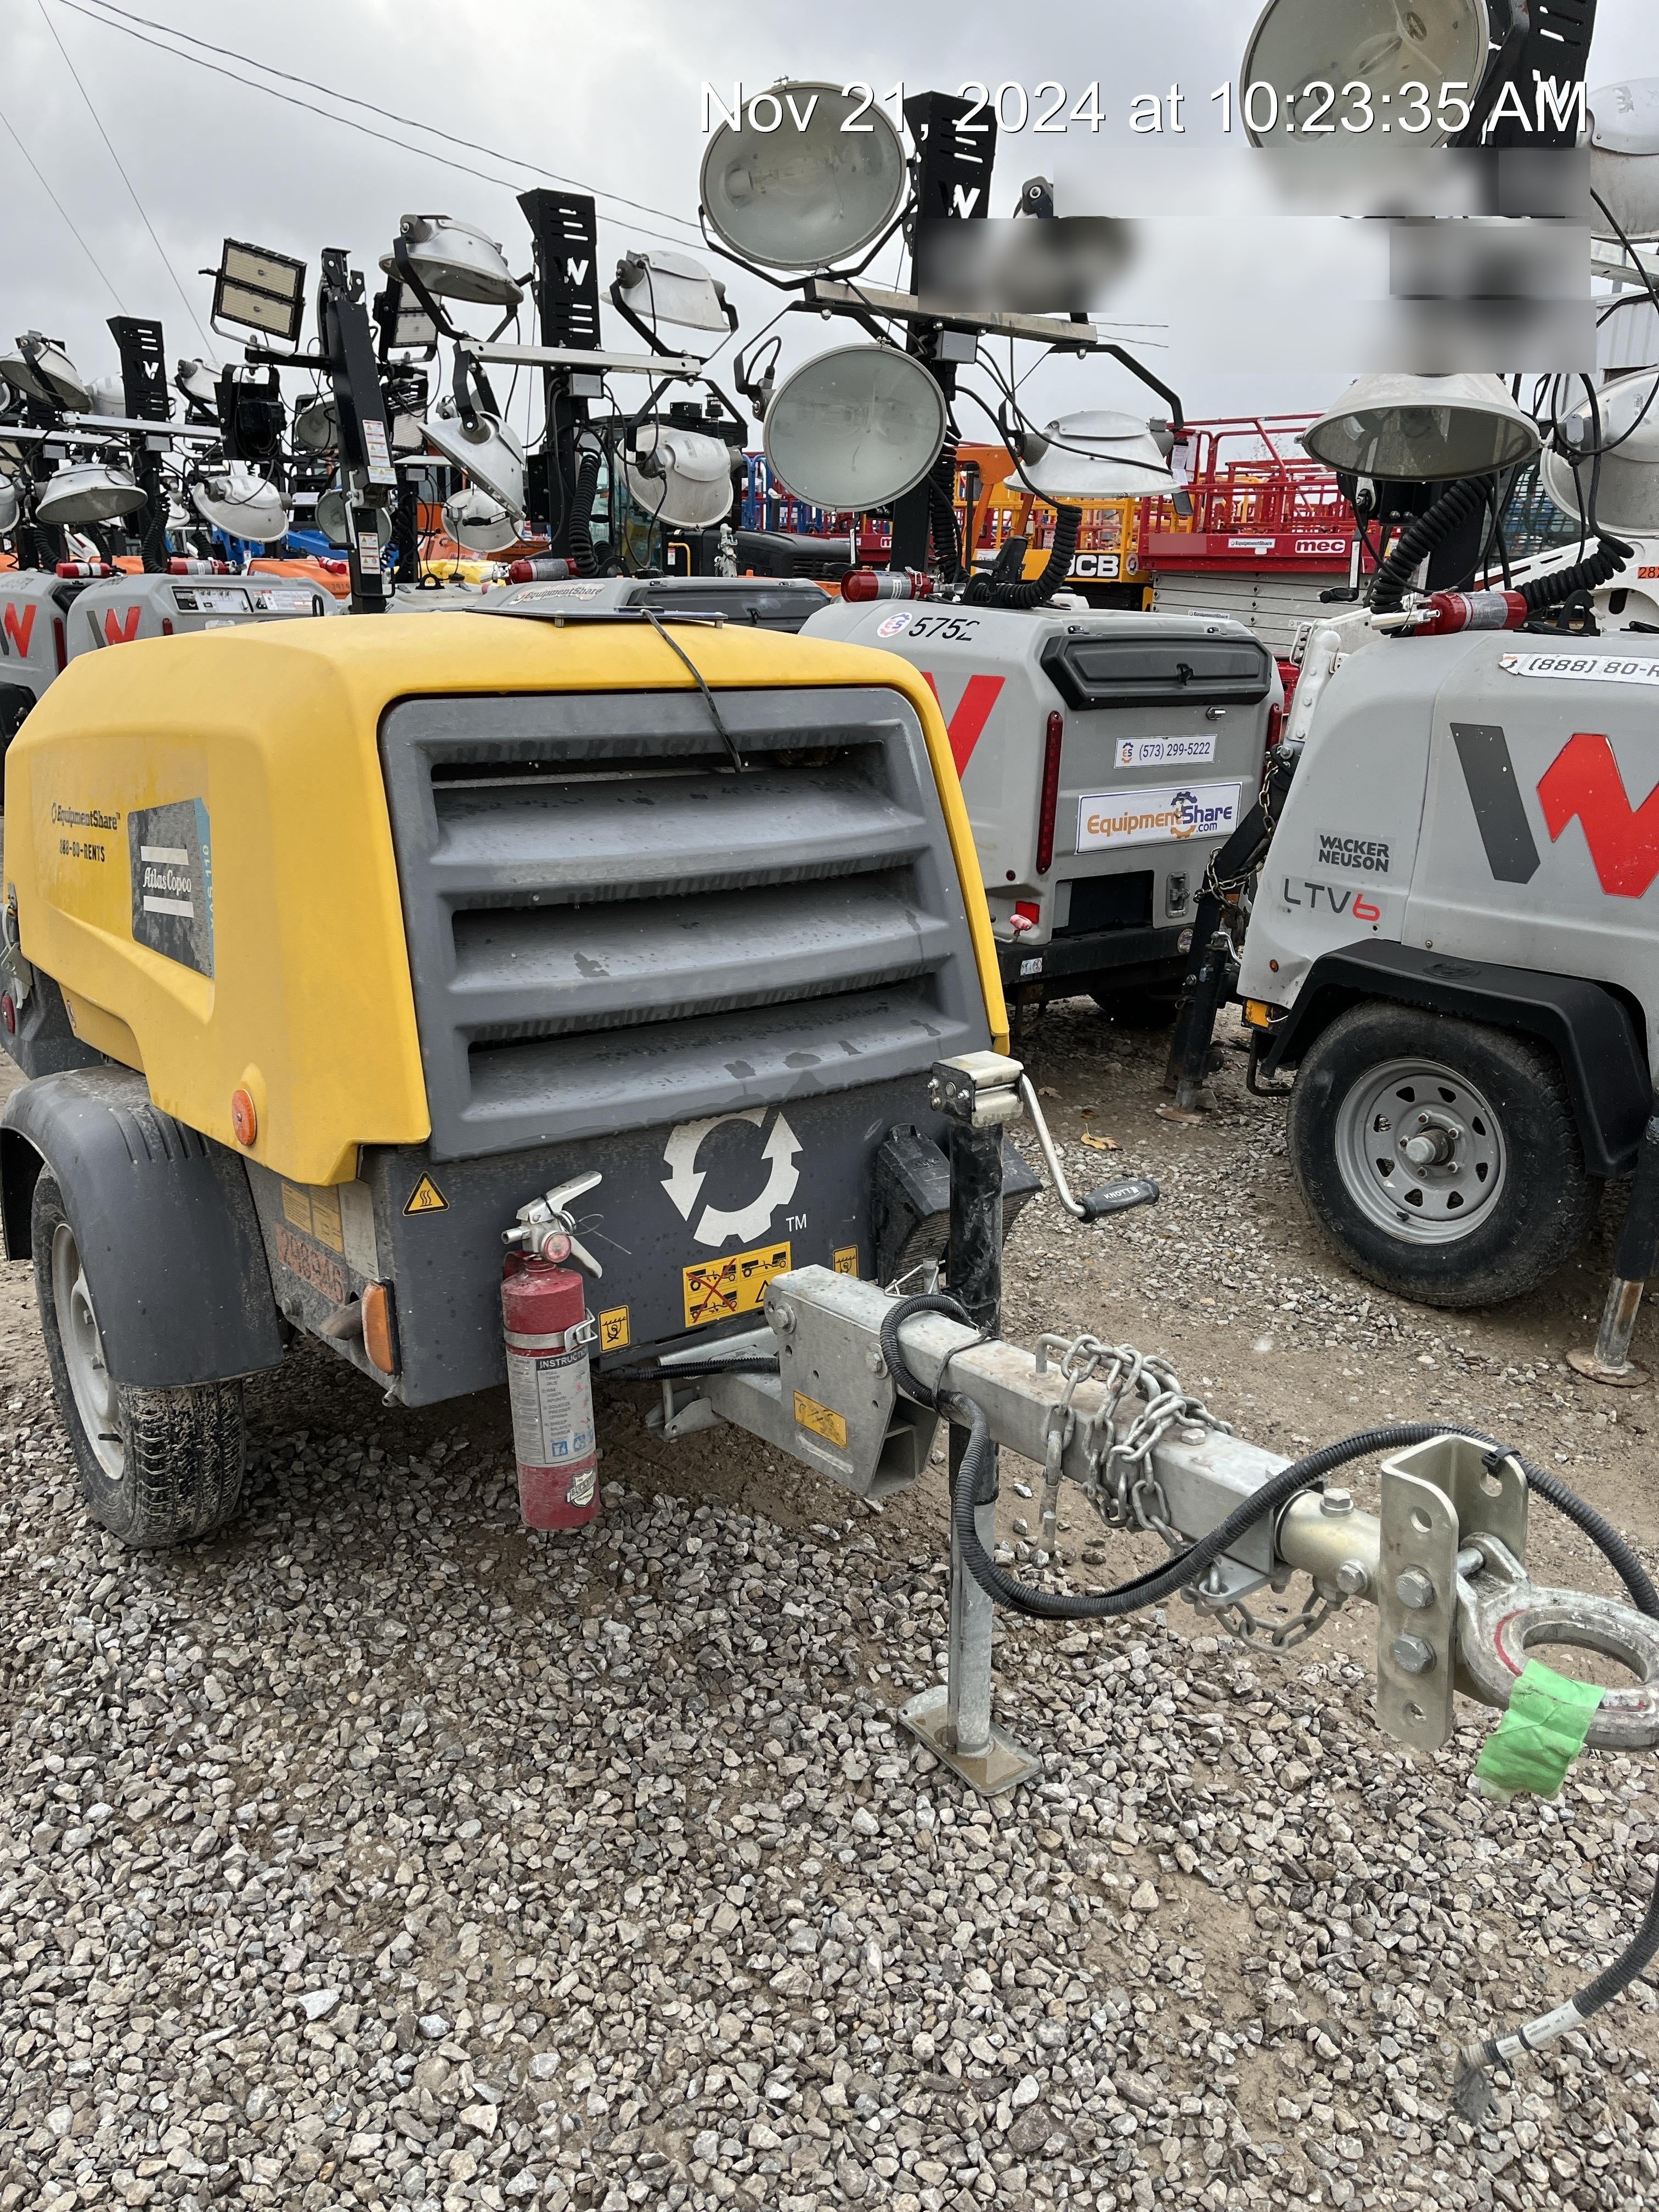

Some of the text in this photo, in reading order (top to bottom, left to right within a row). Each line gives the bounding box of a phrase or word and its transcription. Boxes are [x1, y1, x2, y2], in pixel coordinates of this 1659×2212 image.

[1296, 541, 1344, 551] mec
[524, 587, 603, 599] EquipmentShare
[1528, 658, 1598, 674] (888)
[1139, 743, 1164, 761] (573)
[1166, 742, 1210, 757] 299-5222
[1087, 805, 1232, 837] EquipmentShare
[1196, 822, 1217, 833] .com
[59, 838, 105, 862] 888-80-RENTS
[1319, 834, 1390, 858] WACKER
[1318, 849, 1389, 873] NEUSON
[143, 867, 192, 896] Atlas Copco
[1284, 878, 1380, 922] LTV6
[1103, 1188, 1131, 1200] KNOTT
[786, 1214, 807, 1232] TM
